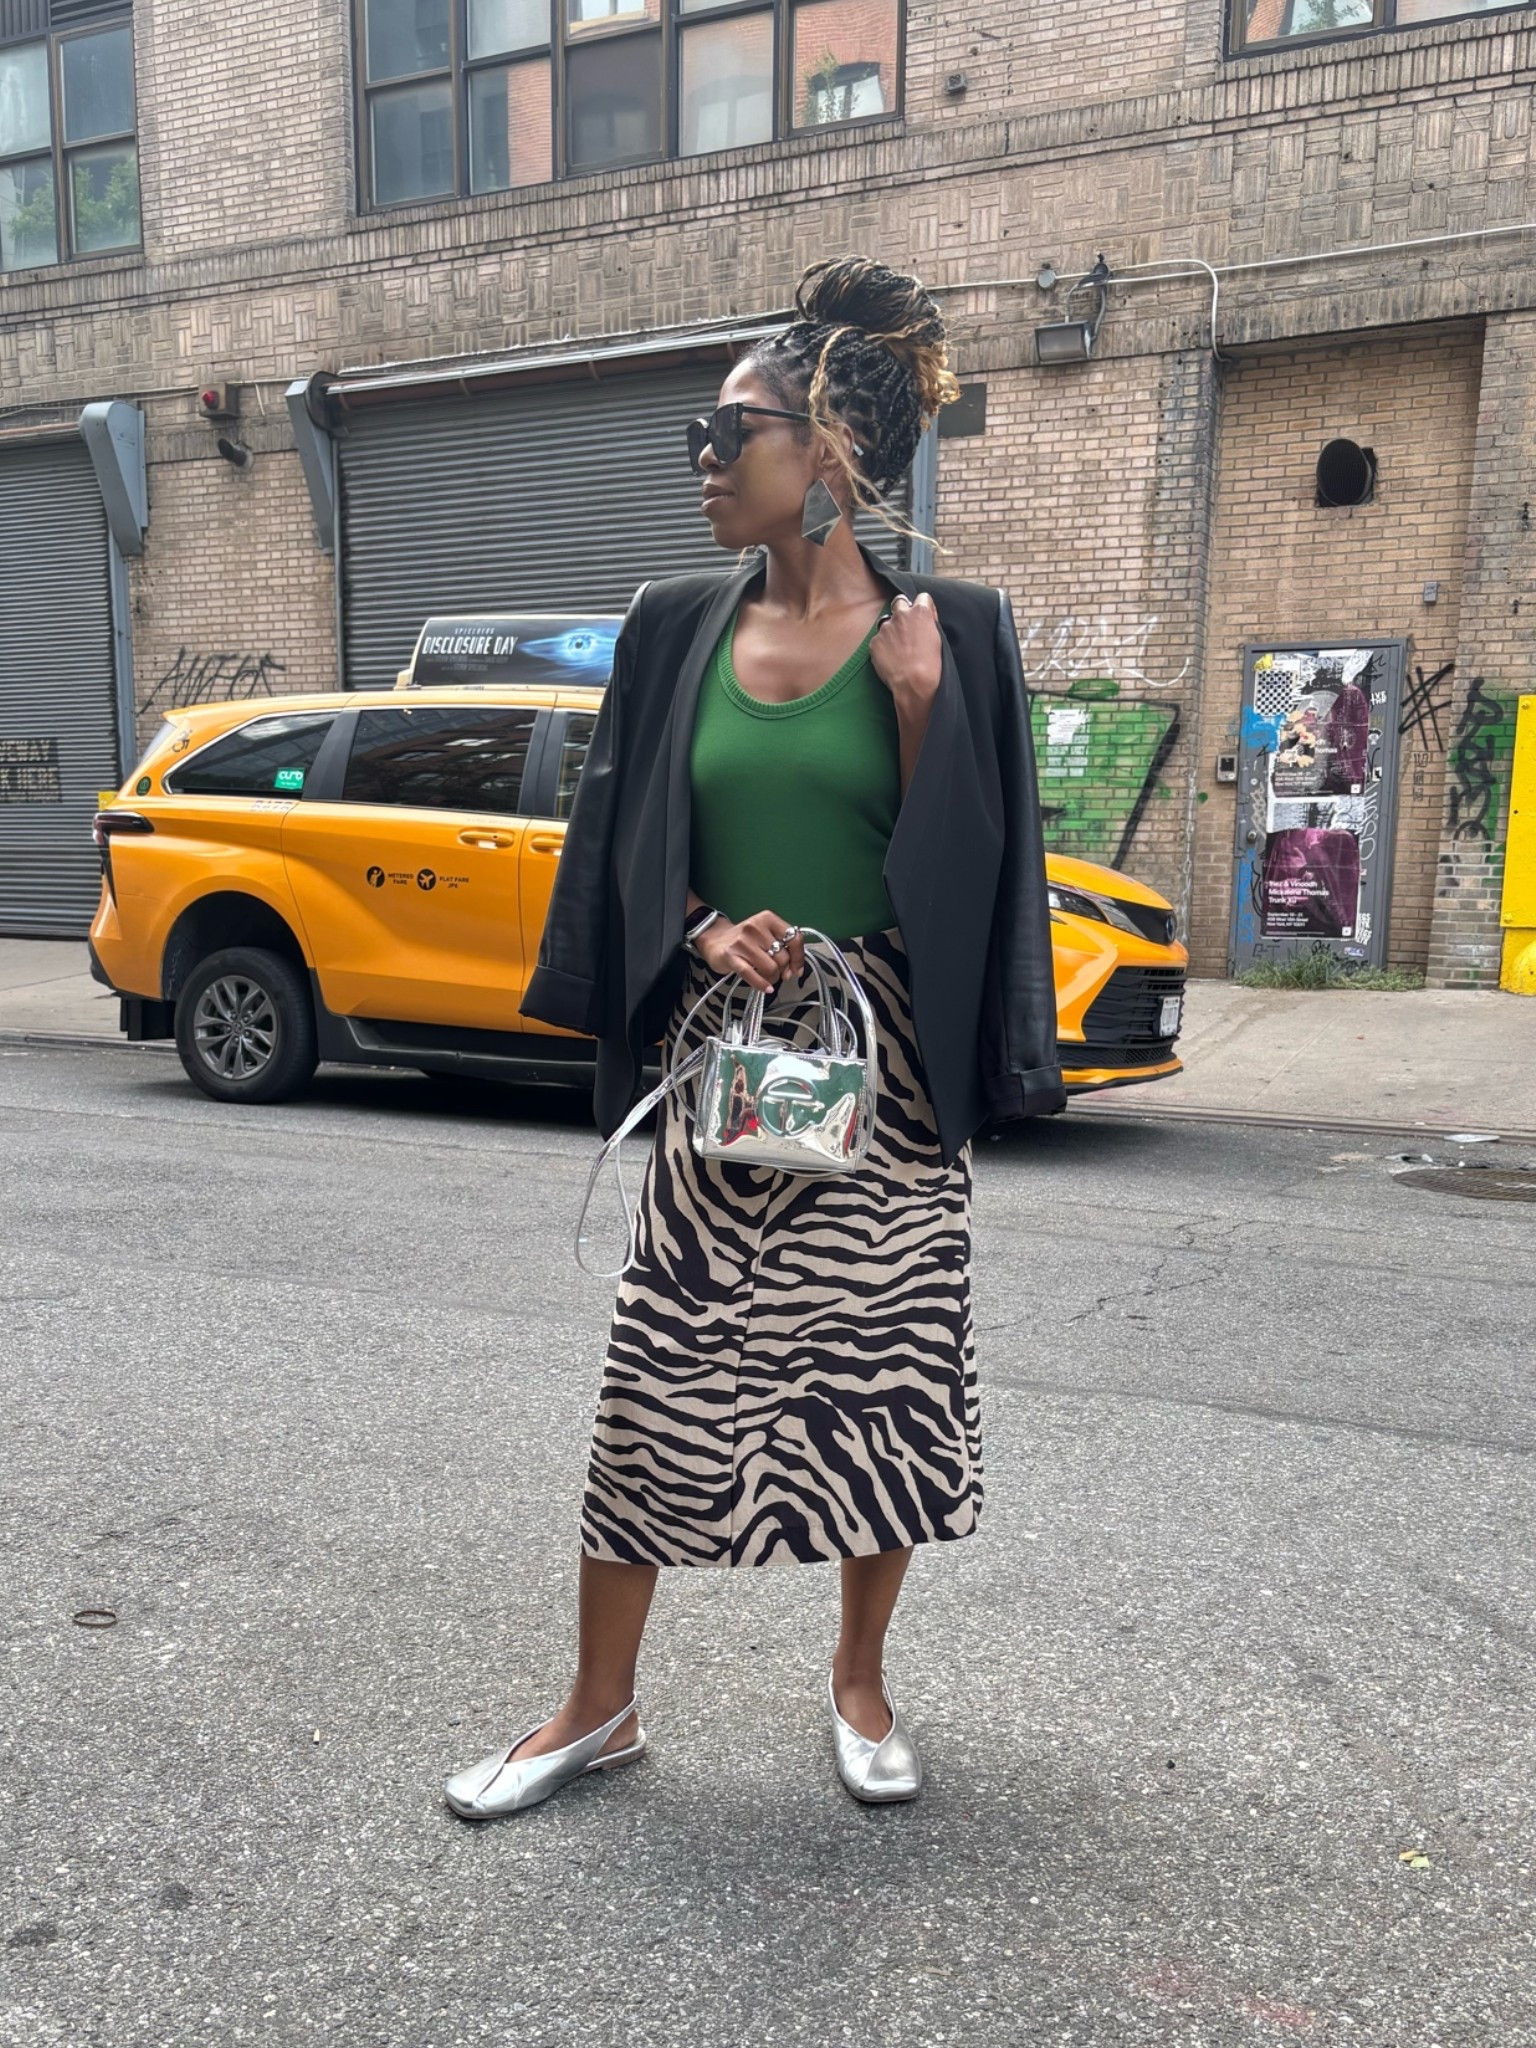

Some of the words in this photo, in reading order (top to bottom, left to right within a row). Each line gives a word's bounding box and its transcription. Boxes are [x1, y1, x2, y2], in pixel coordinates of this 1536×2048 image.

[422, 636, 493, 655] DISCLOSURE
[493, 636, 519, 655] DAY
[278, 770, 303, 781] curb
[1303, 888, 1330, 896] Thomas
